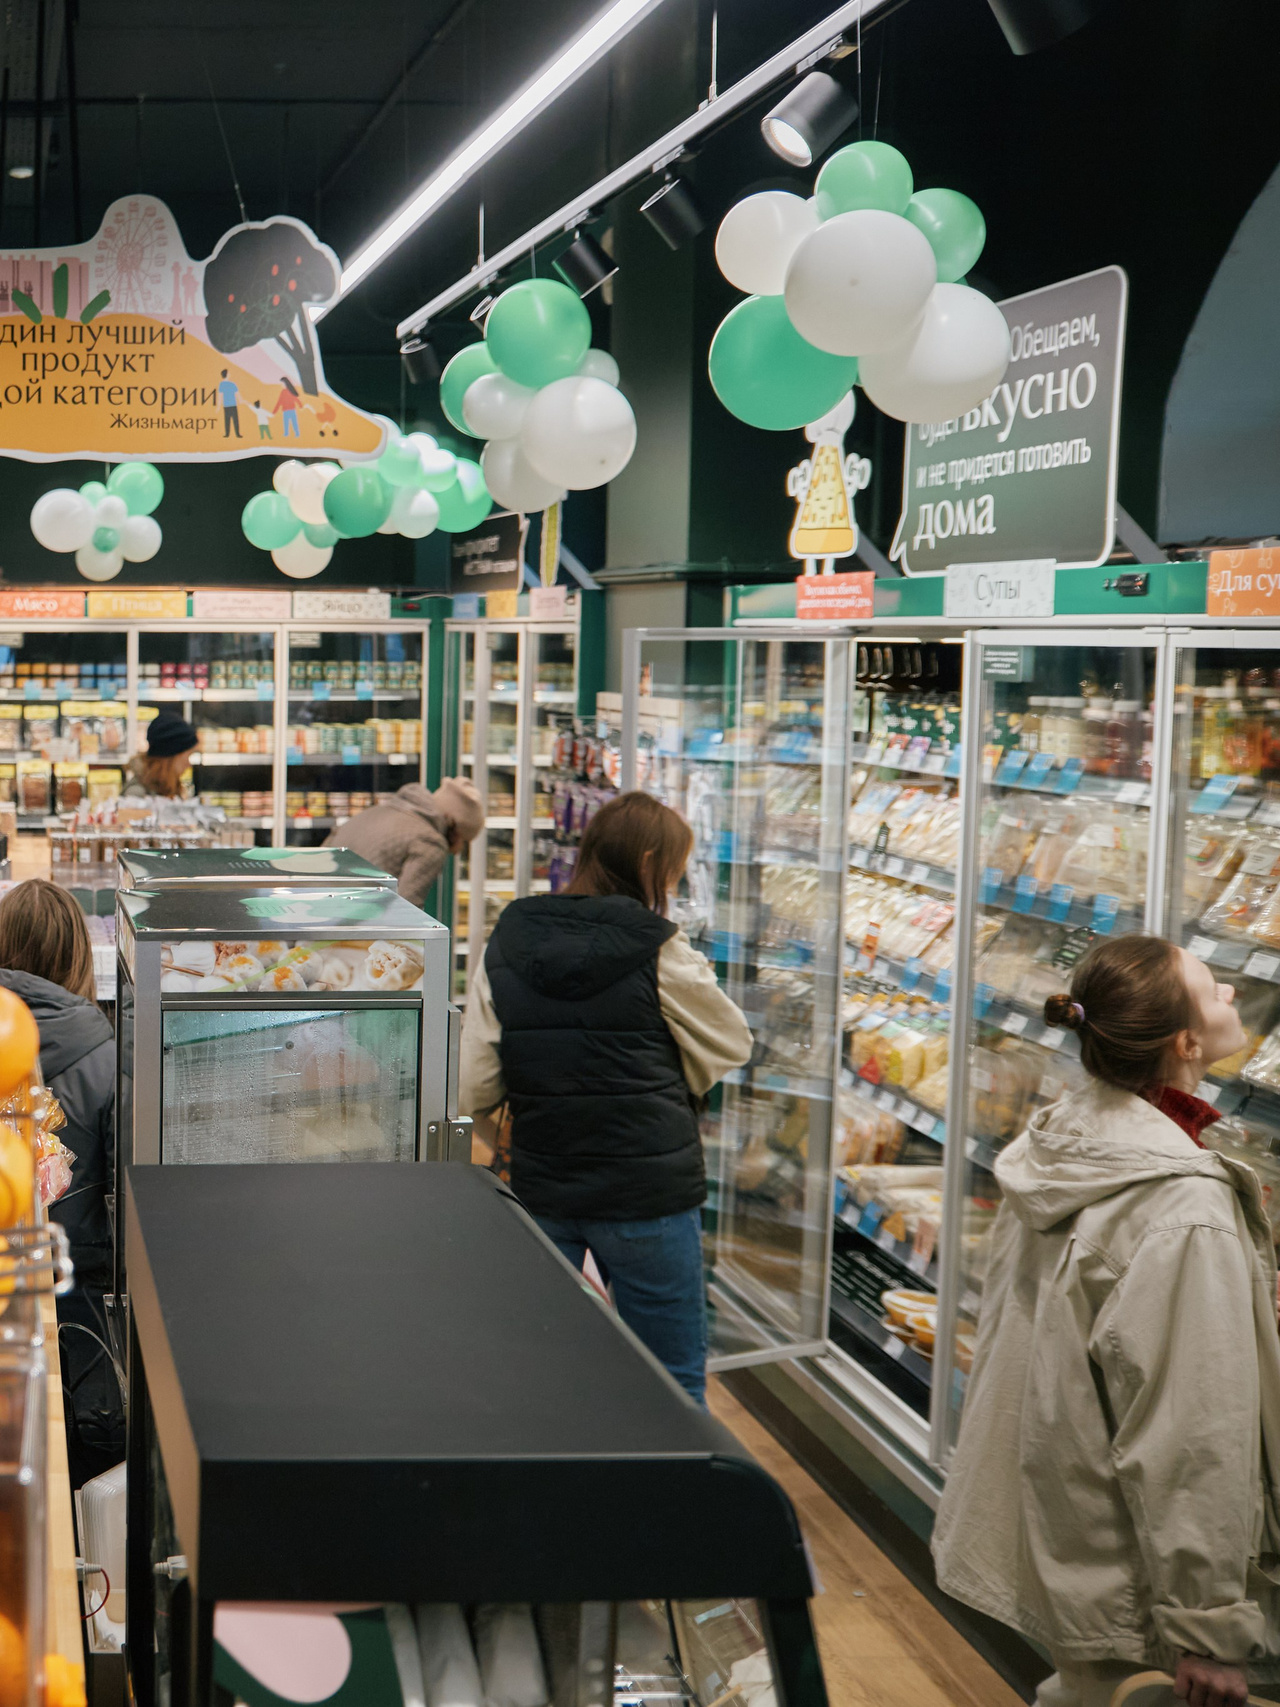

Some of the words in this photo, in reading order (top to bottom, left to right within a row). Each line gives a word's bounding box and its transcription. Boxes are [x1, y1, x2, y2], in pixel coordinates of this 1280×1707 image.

[67, 319, 186, 351] лучший
[1010, 313, 1100, 362] Обещаем,
[21, 351, 155, 380] продукт
[53, 384, 217, 413] категории
[110, 413, 217, 433] Жизньмарт
[916, 466, 927, 488] и
[928, 462, 946, 487] не
[947, 449, 1015, 491] придется
[1017, 437, 1092, 473] готовить
[913, 493, 996, 551] дома
[974, 574, 1021, 607] Супы
[1216, 570, 1253, 597] Для
[13, 597, 59, 612] Мясо
